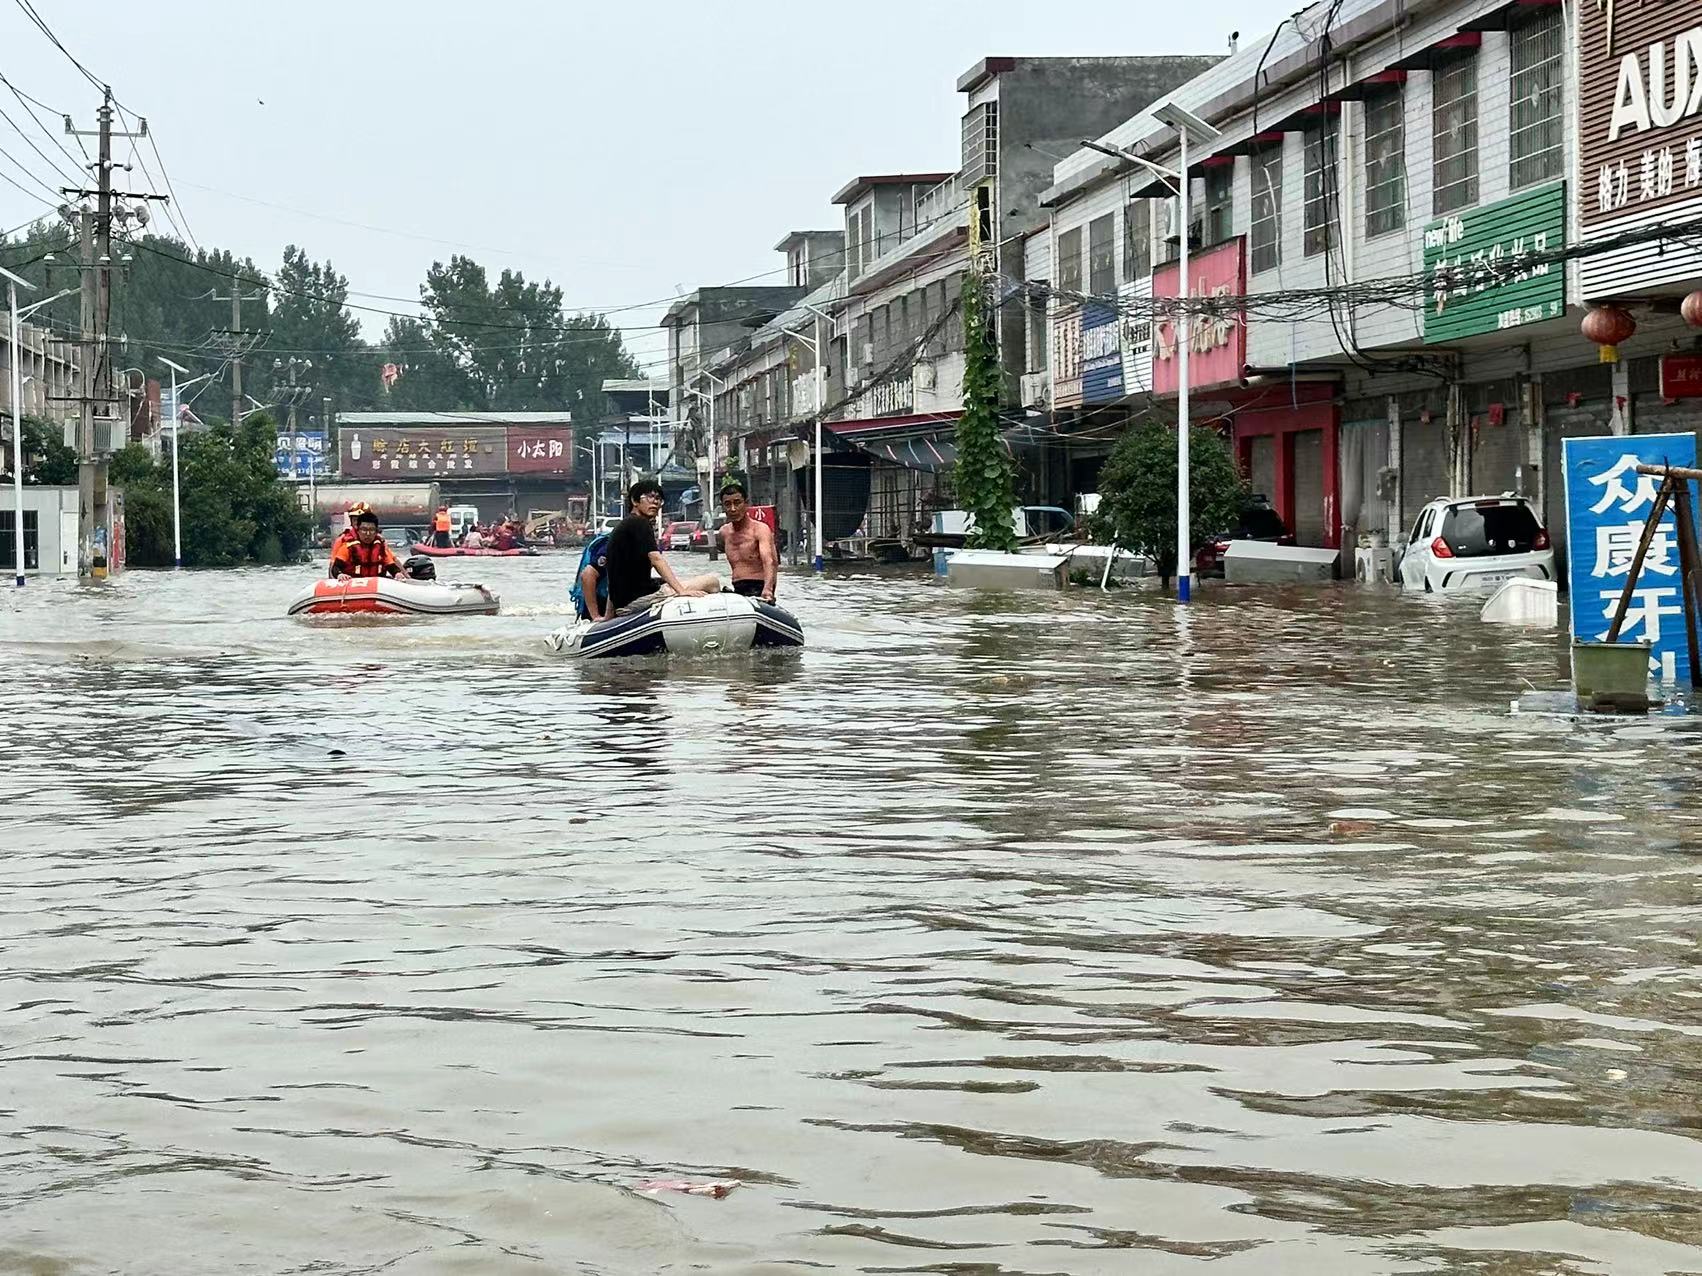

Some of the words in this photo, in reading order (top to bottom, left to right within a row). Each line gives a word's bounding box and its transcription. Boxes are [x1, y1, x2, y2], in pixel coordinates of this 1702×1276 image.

[1598, 158, 1628, 212] 格力
[1640, 147, 1673, 201] 美的
[517, 439, 563, 459] 小太阳
